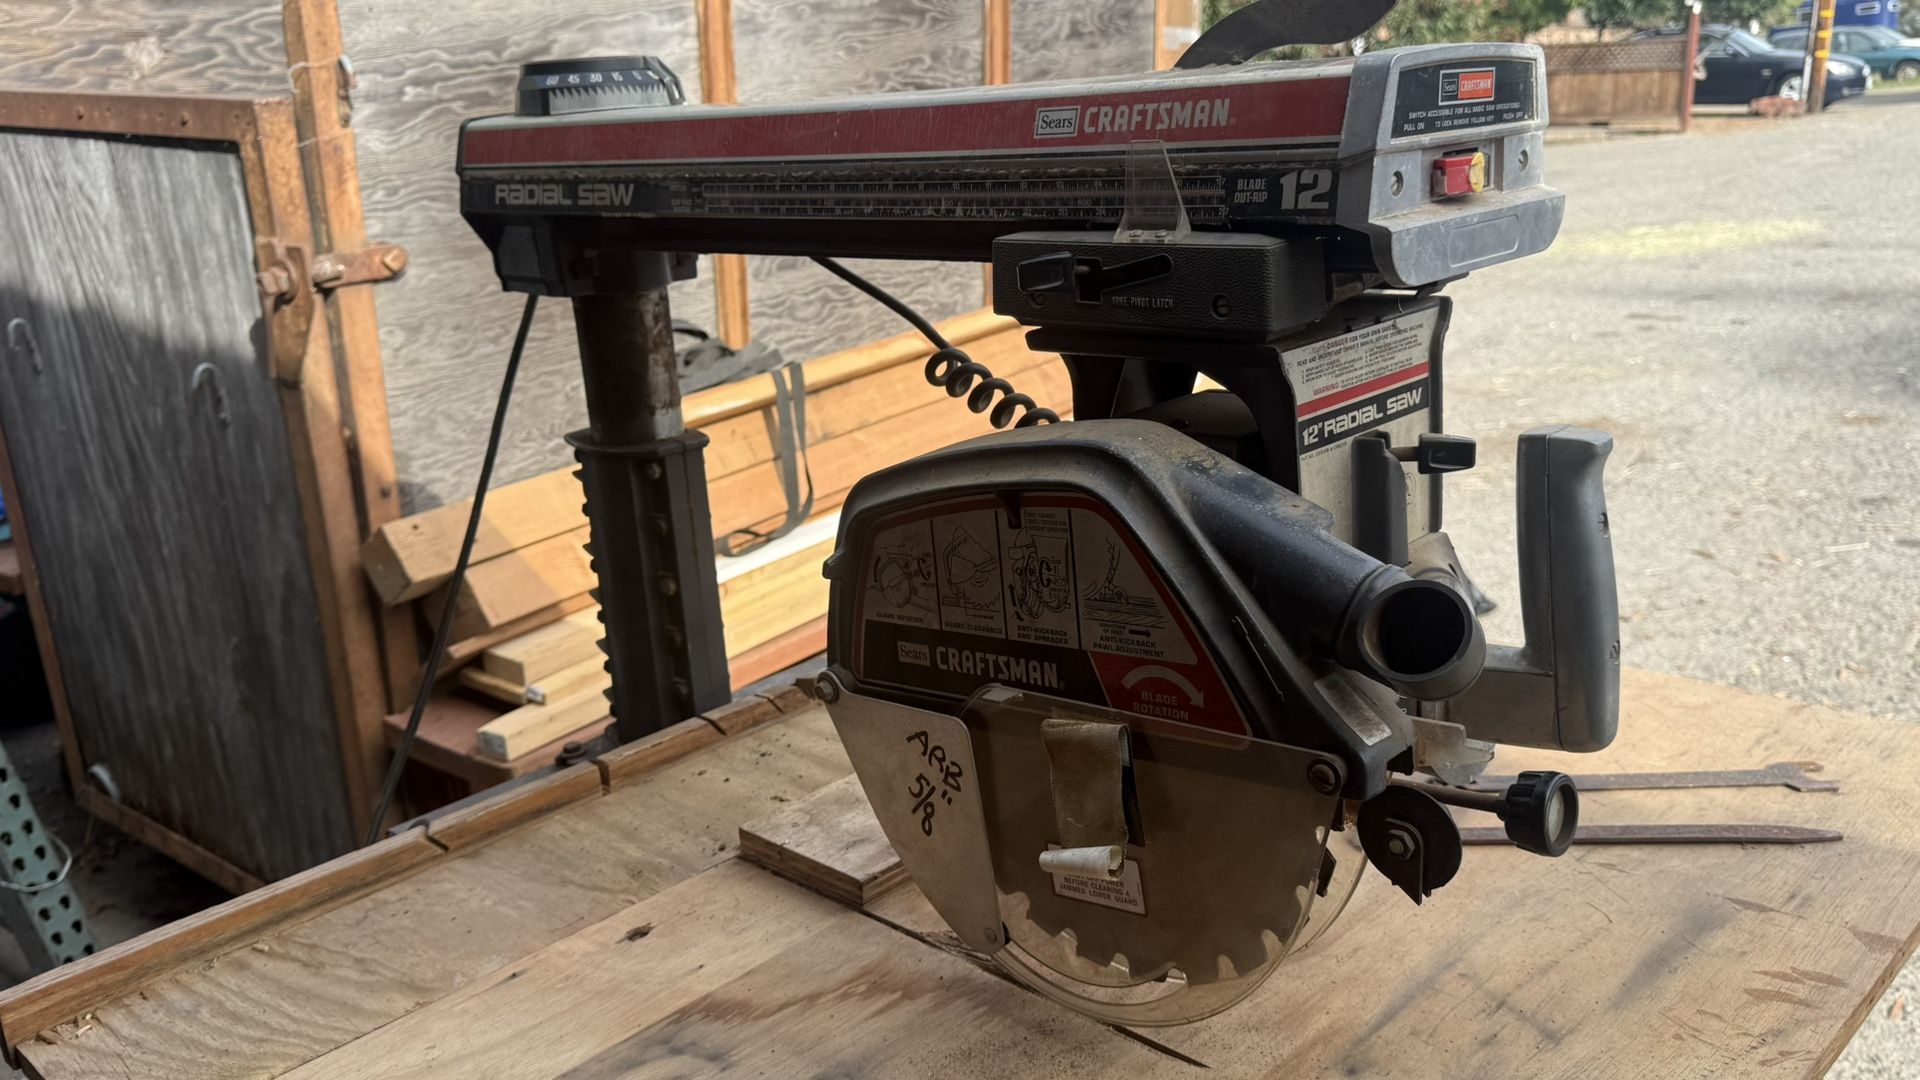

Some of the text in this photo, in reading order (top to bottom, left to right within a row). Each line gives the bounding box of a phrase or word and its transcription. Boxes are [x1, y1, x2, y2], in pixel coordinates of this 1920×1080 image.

[546, 75, 559, 85] 60
[568, 74, 580, 84] 45
[590, 72, 602, 83] 30
[1445, 79, 1491, 92] Sears CRAFTSMAN
[1040, 97, 1231, 134] Sears CRAFTSMAN
[1408, 111, 1426, 119] SWITCH
[1427, 108, 1453, 117] ACCESSIBLE
[1472, 105, 1484, 113] BASIC
[1486, 103, 1495, 111] SAW
[1403, 123, 1416, 131] PULL
[1417, 122, 1424, 130] ON
[1435, 120, 1441, 128] TO
[1441, 119, 1452, 127] LOCK
[1453, 118, 1470, 126] REMOVE
[1470, 116, 1486, 125] YELLOW
[1486, 115, 1494, 123] KEY
[1237, 178, 1266, 190] BLADE
[1279, 168, 1333, 210] 12
[577, 183, 635, 206] SAW
[1234, 191, 1268, 204] OUT-RIP
[1111, 295, 1173, 309] YOKE PIVOT LATCH
[1327, 337, 1348, 350] DANGER
[1359, 332, 1370, 341] YOUR
[1371, 329, 1381, 337] OWN
[1386, 387, 1423, 415] SAW
[967, 623, 1003, 635] CLEARANCE
[1017, 625, 1068, 637] ANTI-KICKBACK
[1017, 632, 1069, 645] AND SPREADER
[1100, 635, 1155, 648] ANTI-KICKBACK
[1115, 646, 1164, 658] ADJUSTMENT
[900, 645, 1059, 688] Sears CRAFTSMAN
[1141, 691, 1178, 706] BLADE
[1133, 702, 1189, 720] ROTATION
[906, 730, 963, 792] ARB
[1064, 876, 1089, 889] BEFORE
[1090, 882, 1123, 895] CLEARING
[1060, 883, 1138, 906] JAMMED LOWER GUARD
